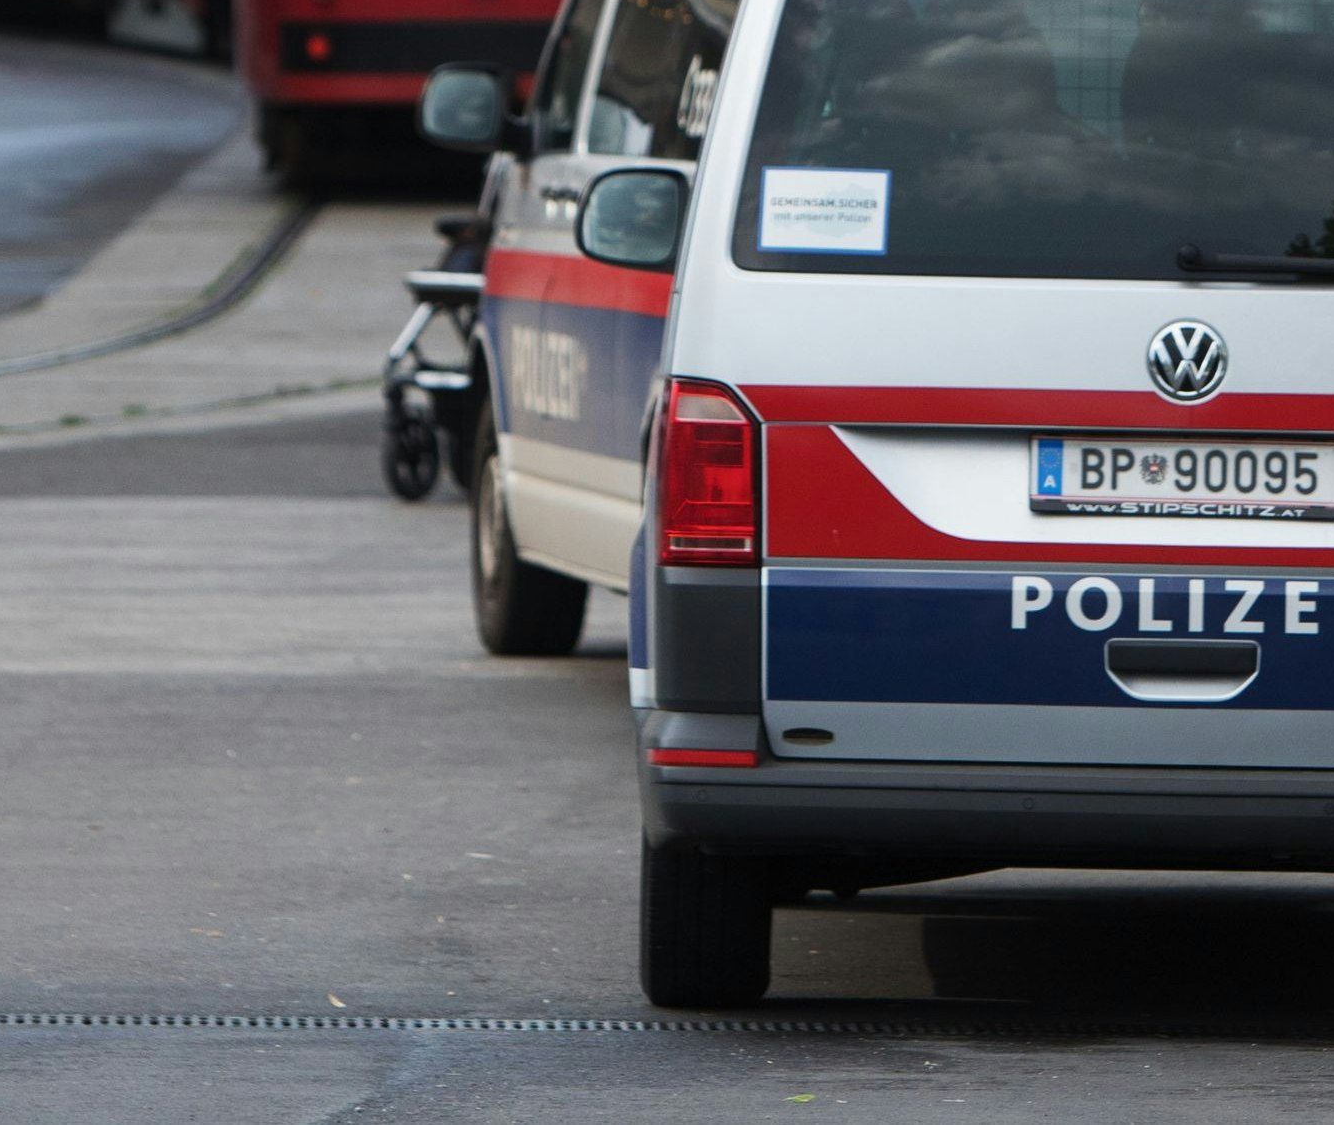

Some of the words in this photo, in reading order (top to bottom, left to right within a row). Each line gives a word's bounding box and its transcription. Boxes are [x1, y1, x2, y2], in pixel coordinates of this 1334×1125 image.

[773, 213, 791, 221] mit
[795, 213, 834, 222] unserer
[837, 213, 873, 223] Polizei
[1080, 447, 1135, 491] BP
[1173, 449, 1320, 495] 90095
[1043, 475, 1056, 488] A
